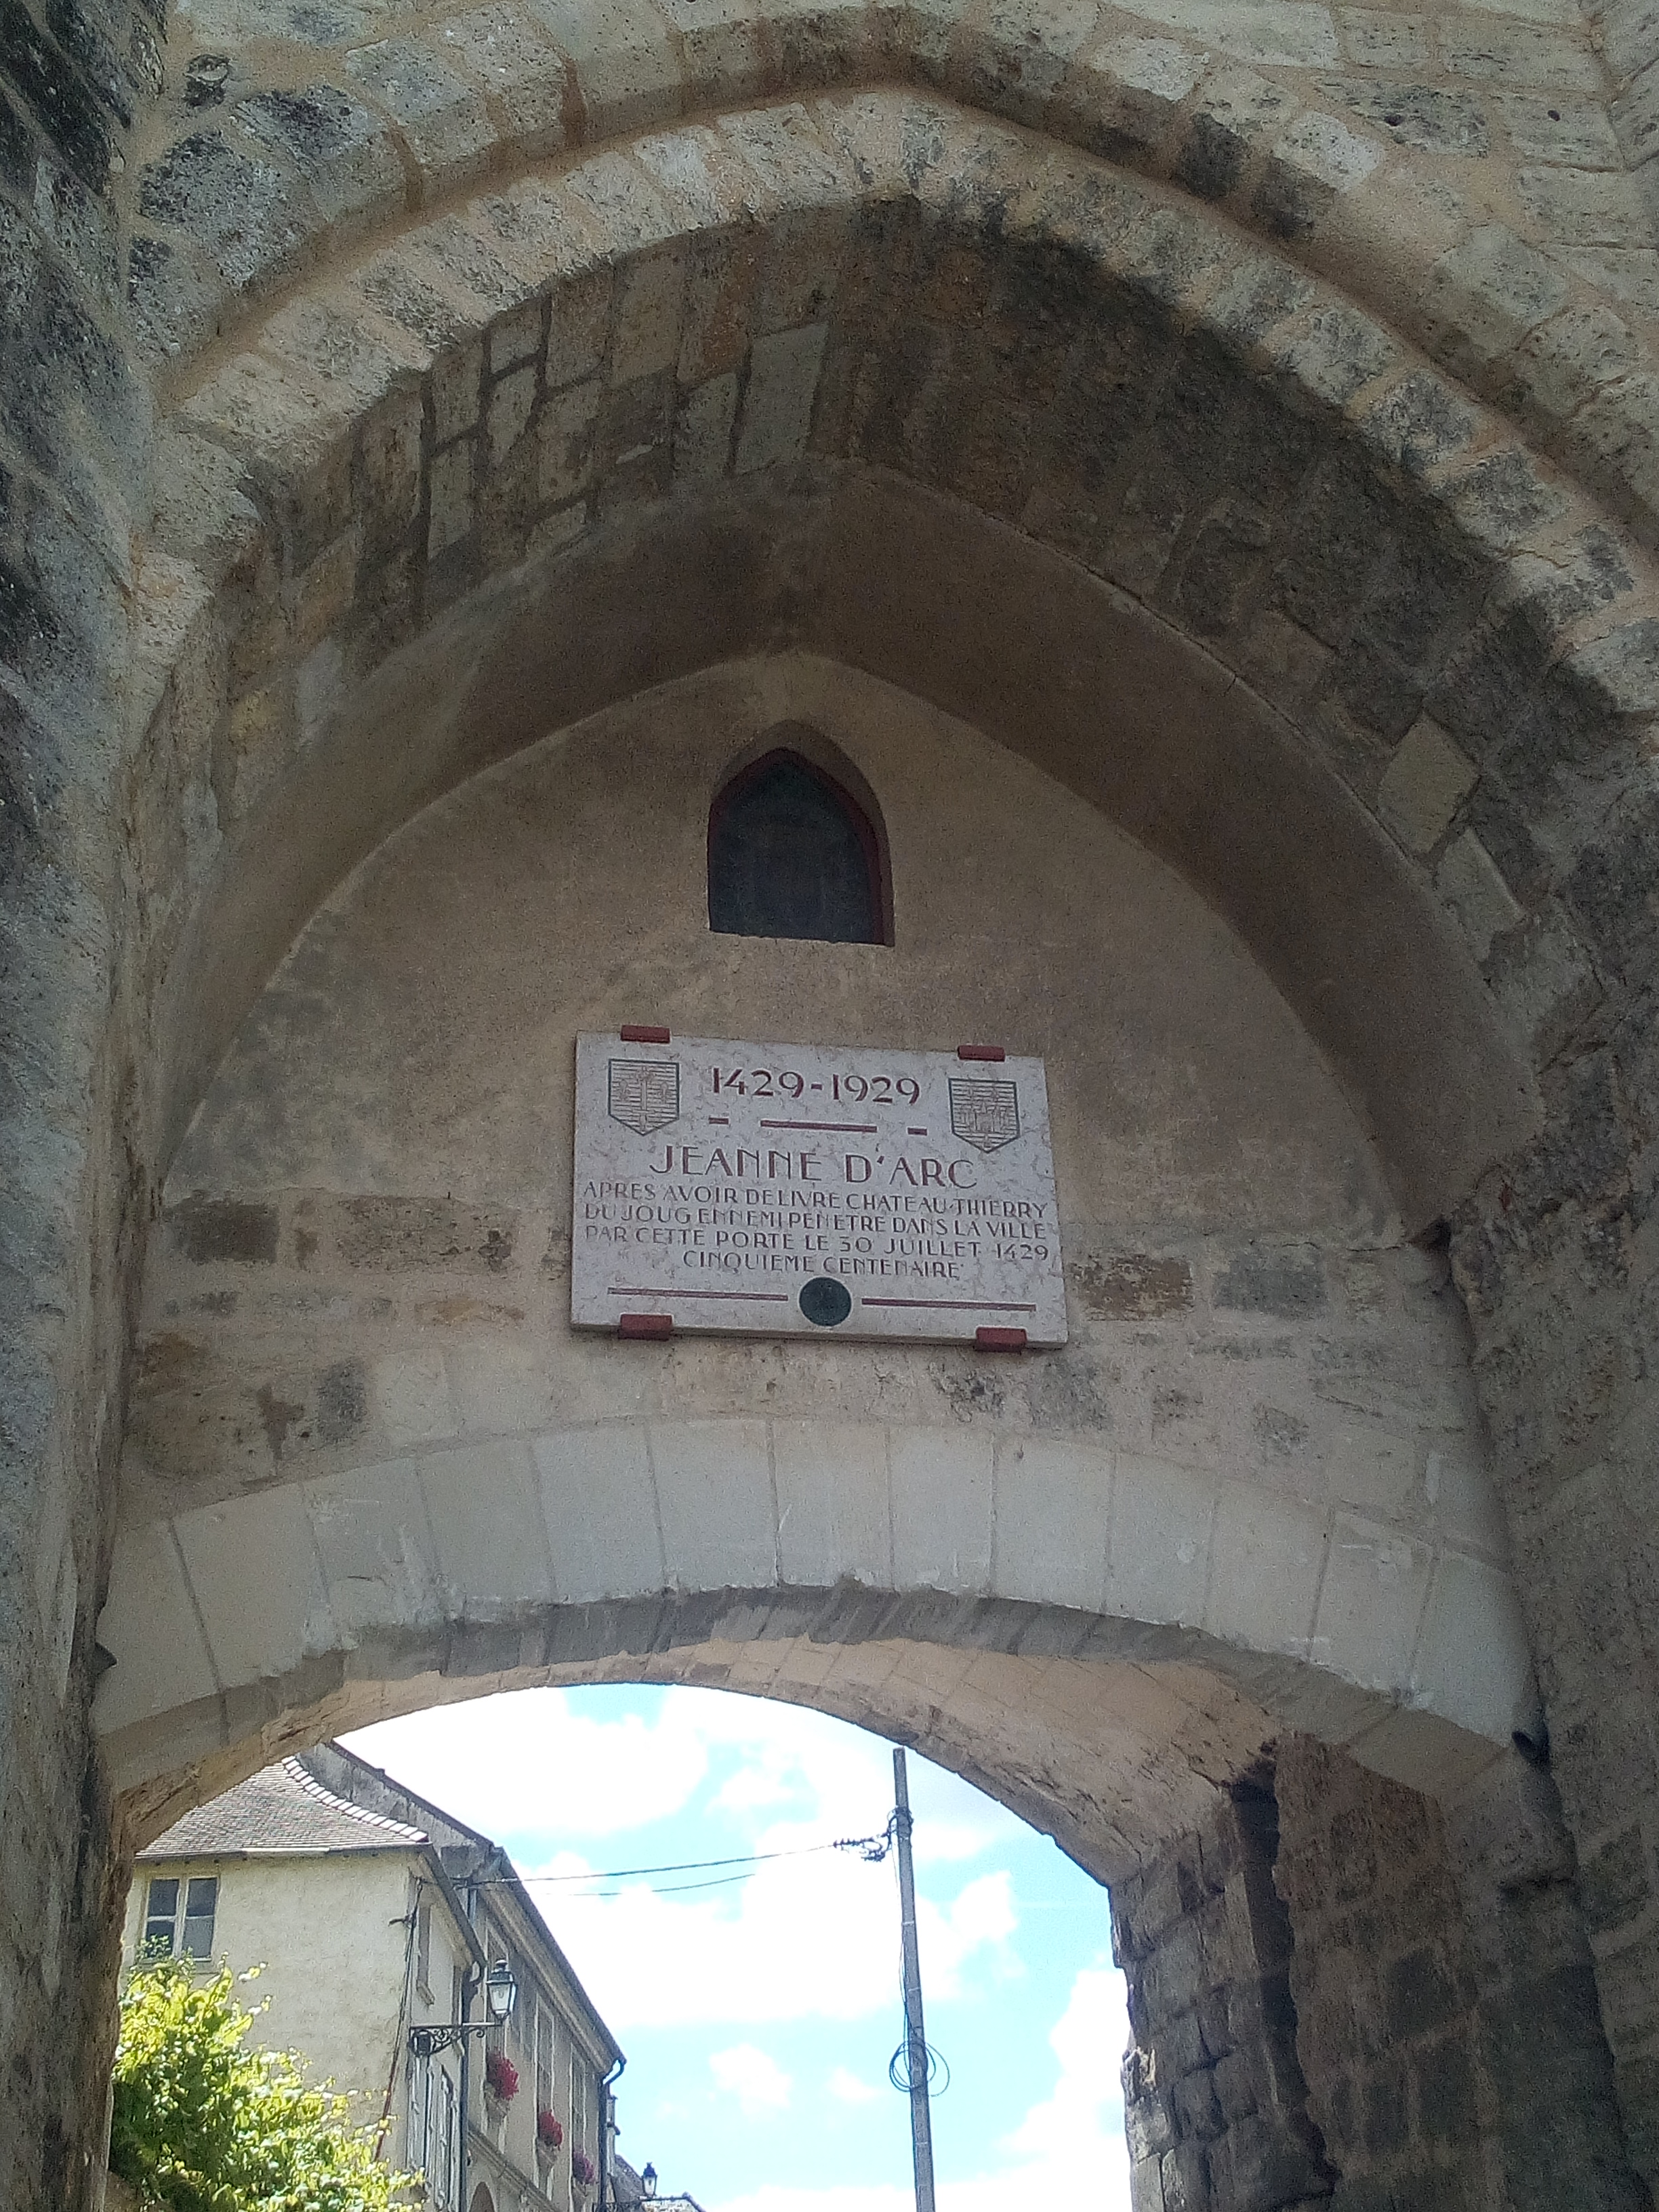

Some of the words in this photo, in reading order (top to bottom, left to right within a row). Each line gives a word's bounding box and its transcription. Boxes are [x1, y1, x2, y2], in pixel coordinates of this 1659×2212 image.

[713, 1068, 920, 1105] 1429-1929
[649, 1145, 821, 1181] JEANNE
[846, 1153, 977, 1189] D'ARC
[584, 1181, 656, 1200] APRES
[663, 1185, 737, 1204] AVOIR
[747, 1189, 840, 1208] DELIVRE
[586, 1203, 615, 1220] DU
[621, 1205, 691, 1224] JOUG
[699, 1208, 781, 1227] ENNEMI
[790, 1212, 886, 1232] PENETRE
[893, 1217, 947, 1235] DANS
[955, 1220, 981, 1237] LA
[987, 1221, 1046, 1239] VILLE
[586, 1225, 627, 1242] PAR
[636, 1227, 705, 1245] CETTE
[716, 1231, 794, 1249] PORTE
[806, 1235, 829, 1250] LE
[884, 1238, 981, 1257] JUILLET
[996, 1244, 1048, 1260] 1429
[683, 1250, 814, 1273] CINQUIEME
[823, 1256, 959, 1278] CENTENAIRE
